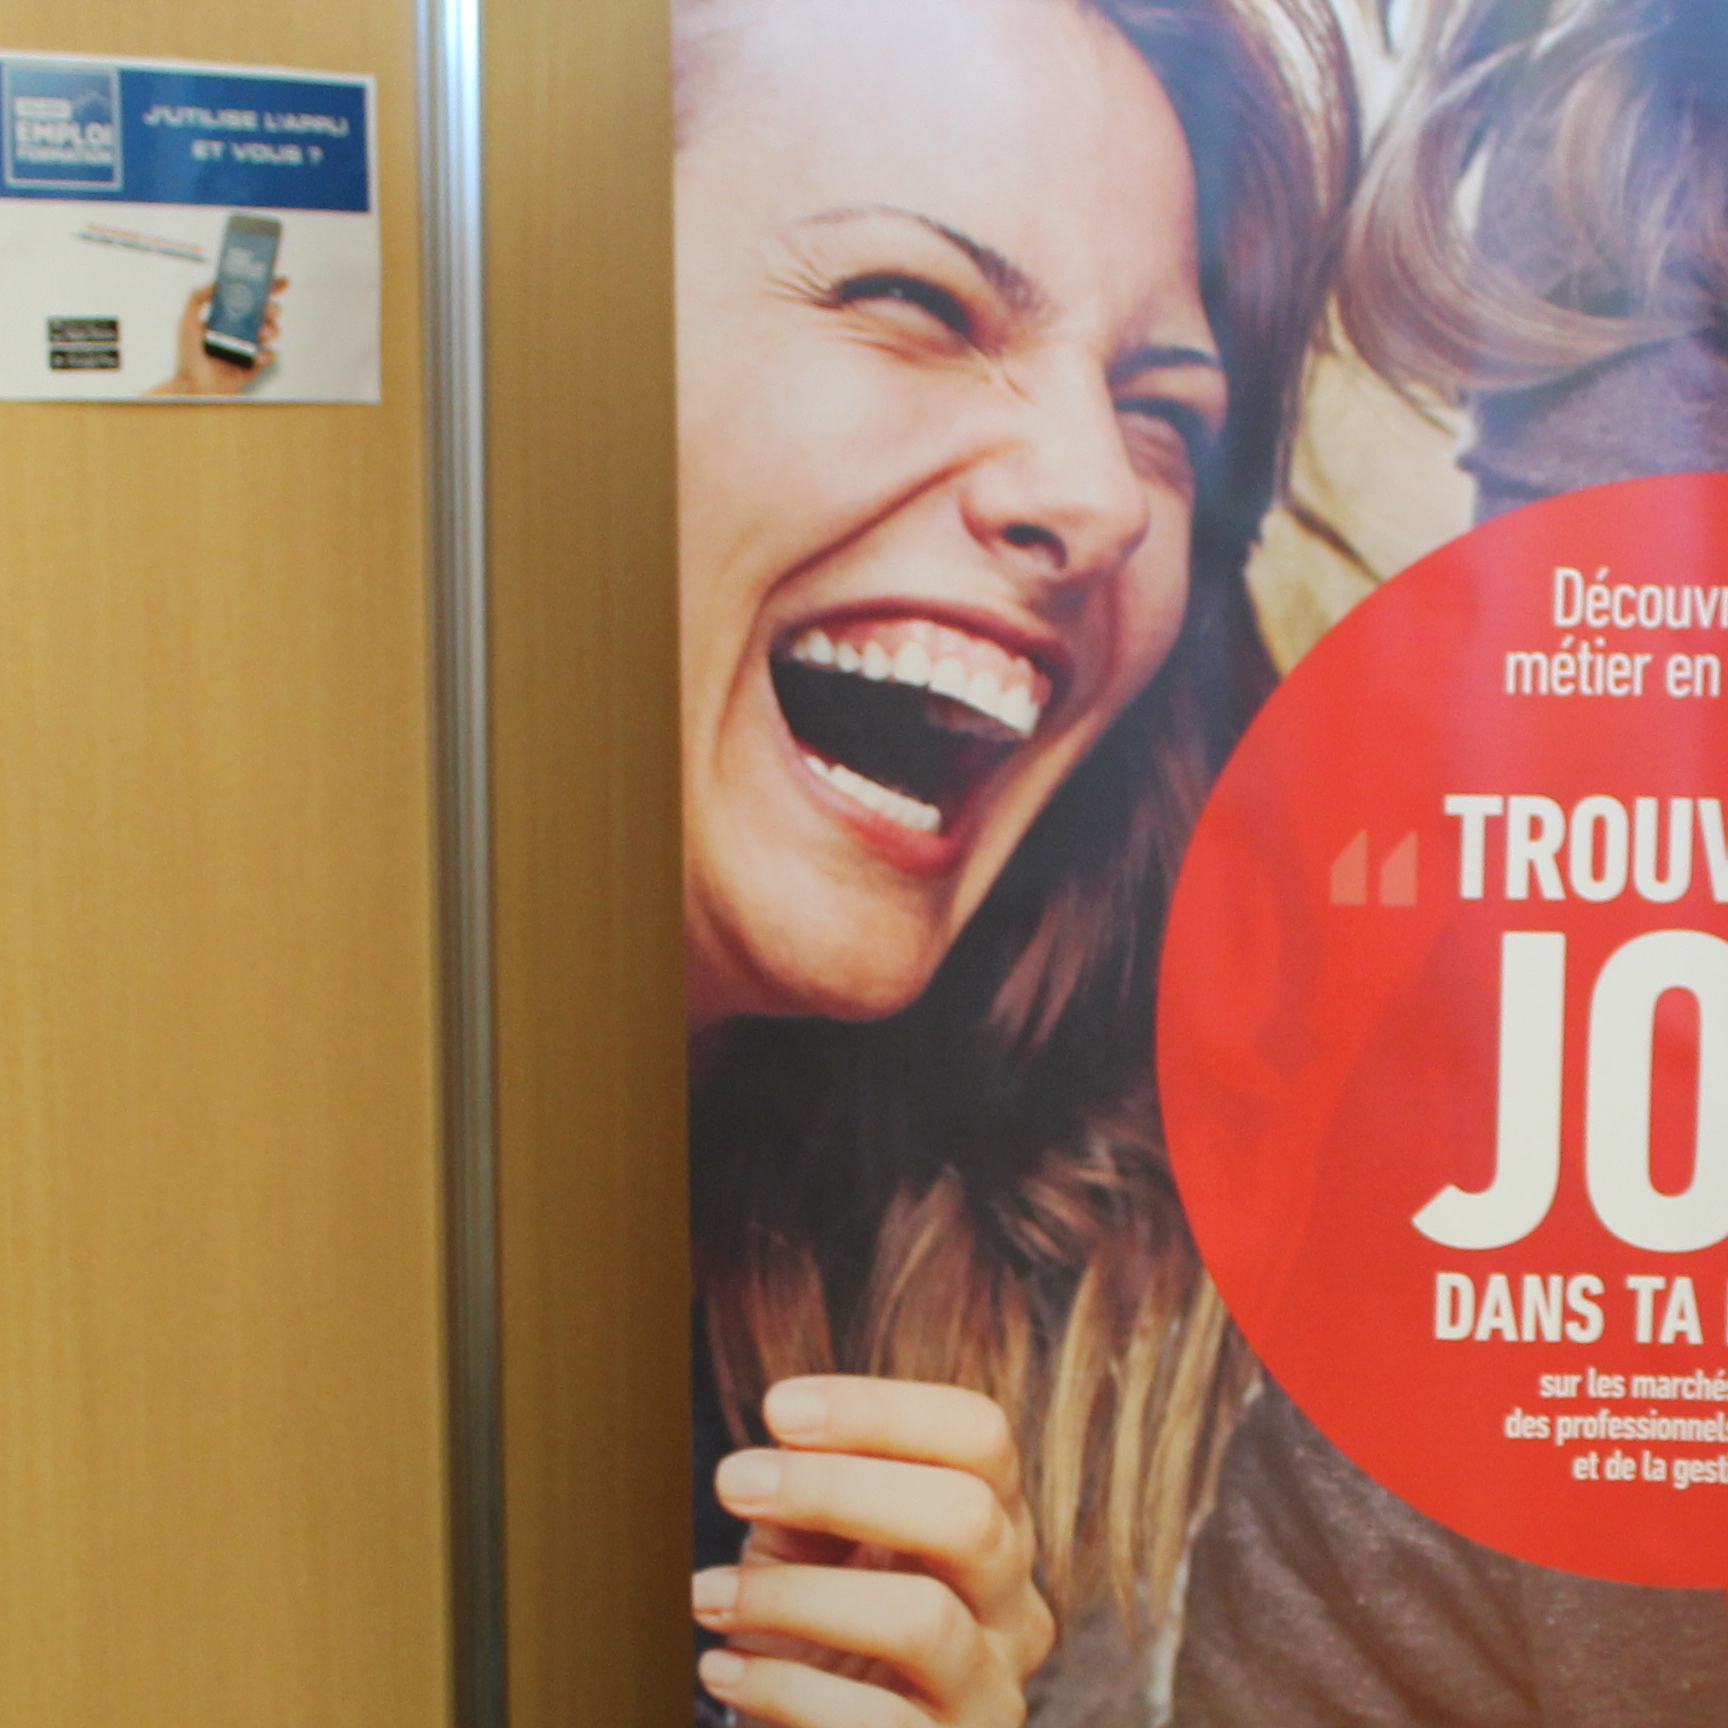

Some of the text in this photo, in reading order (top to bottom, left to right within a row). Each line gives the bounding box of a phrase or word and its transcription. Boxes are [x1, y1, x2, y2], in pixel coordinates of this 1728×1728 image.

[193, 140, 224, 161] ET
[1505, 636, 1653, 697] métier
[1667, 653, 1721, 698] en
[1434, 1271, 1604, 1344] DANS
[1625, 1275, 1703, 1345] TA
[1539, 1373, 1583, 1398] sur
[1587, 1367, 1626, 1399] les
[1504, 1407, 1551, 1439] des
[1572, 1451, 1600, 1481] et
[1604, 1449, 1637, 1481] de
[1641, 1450, 1668, 1482] la
